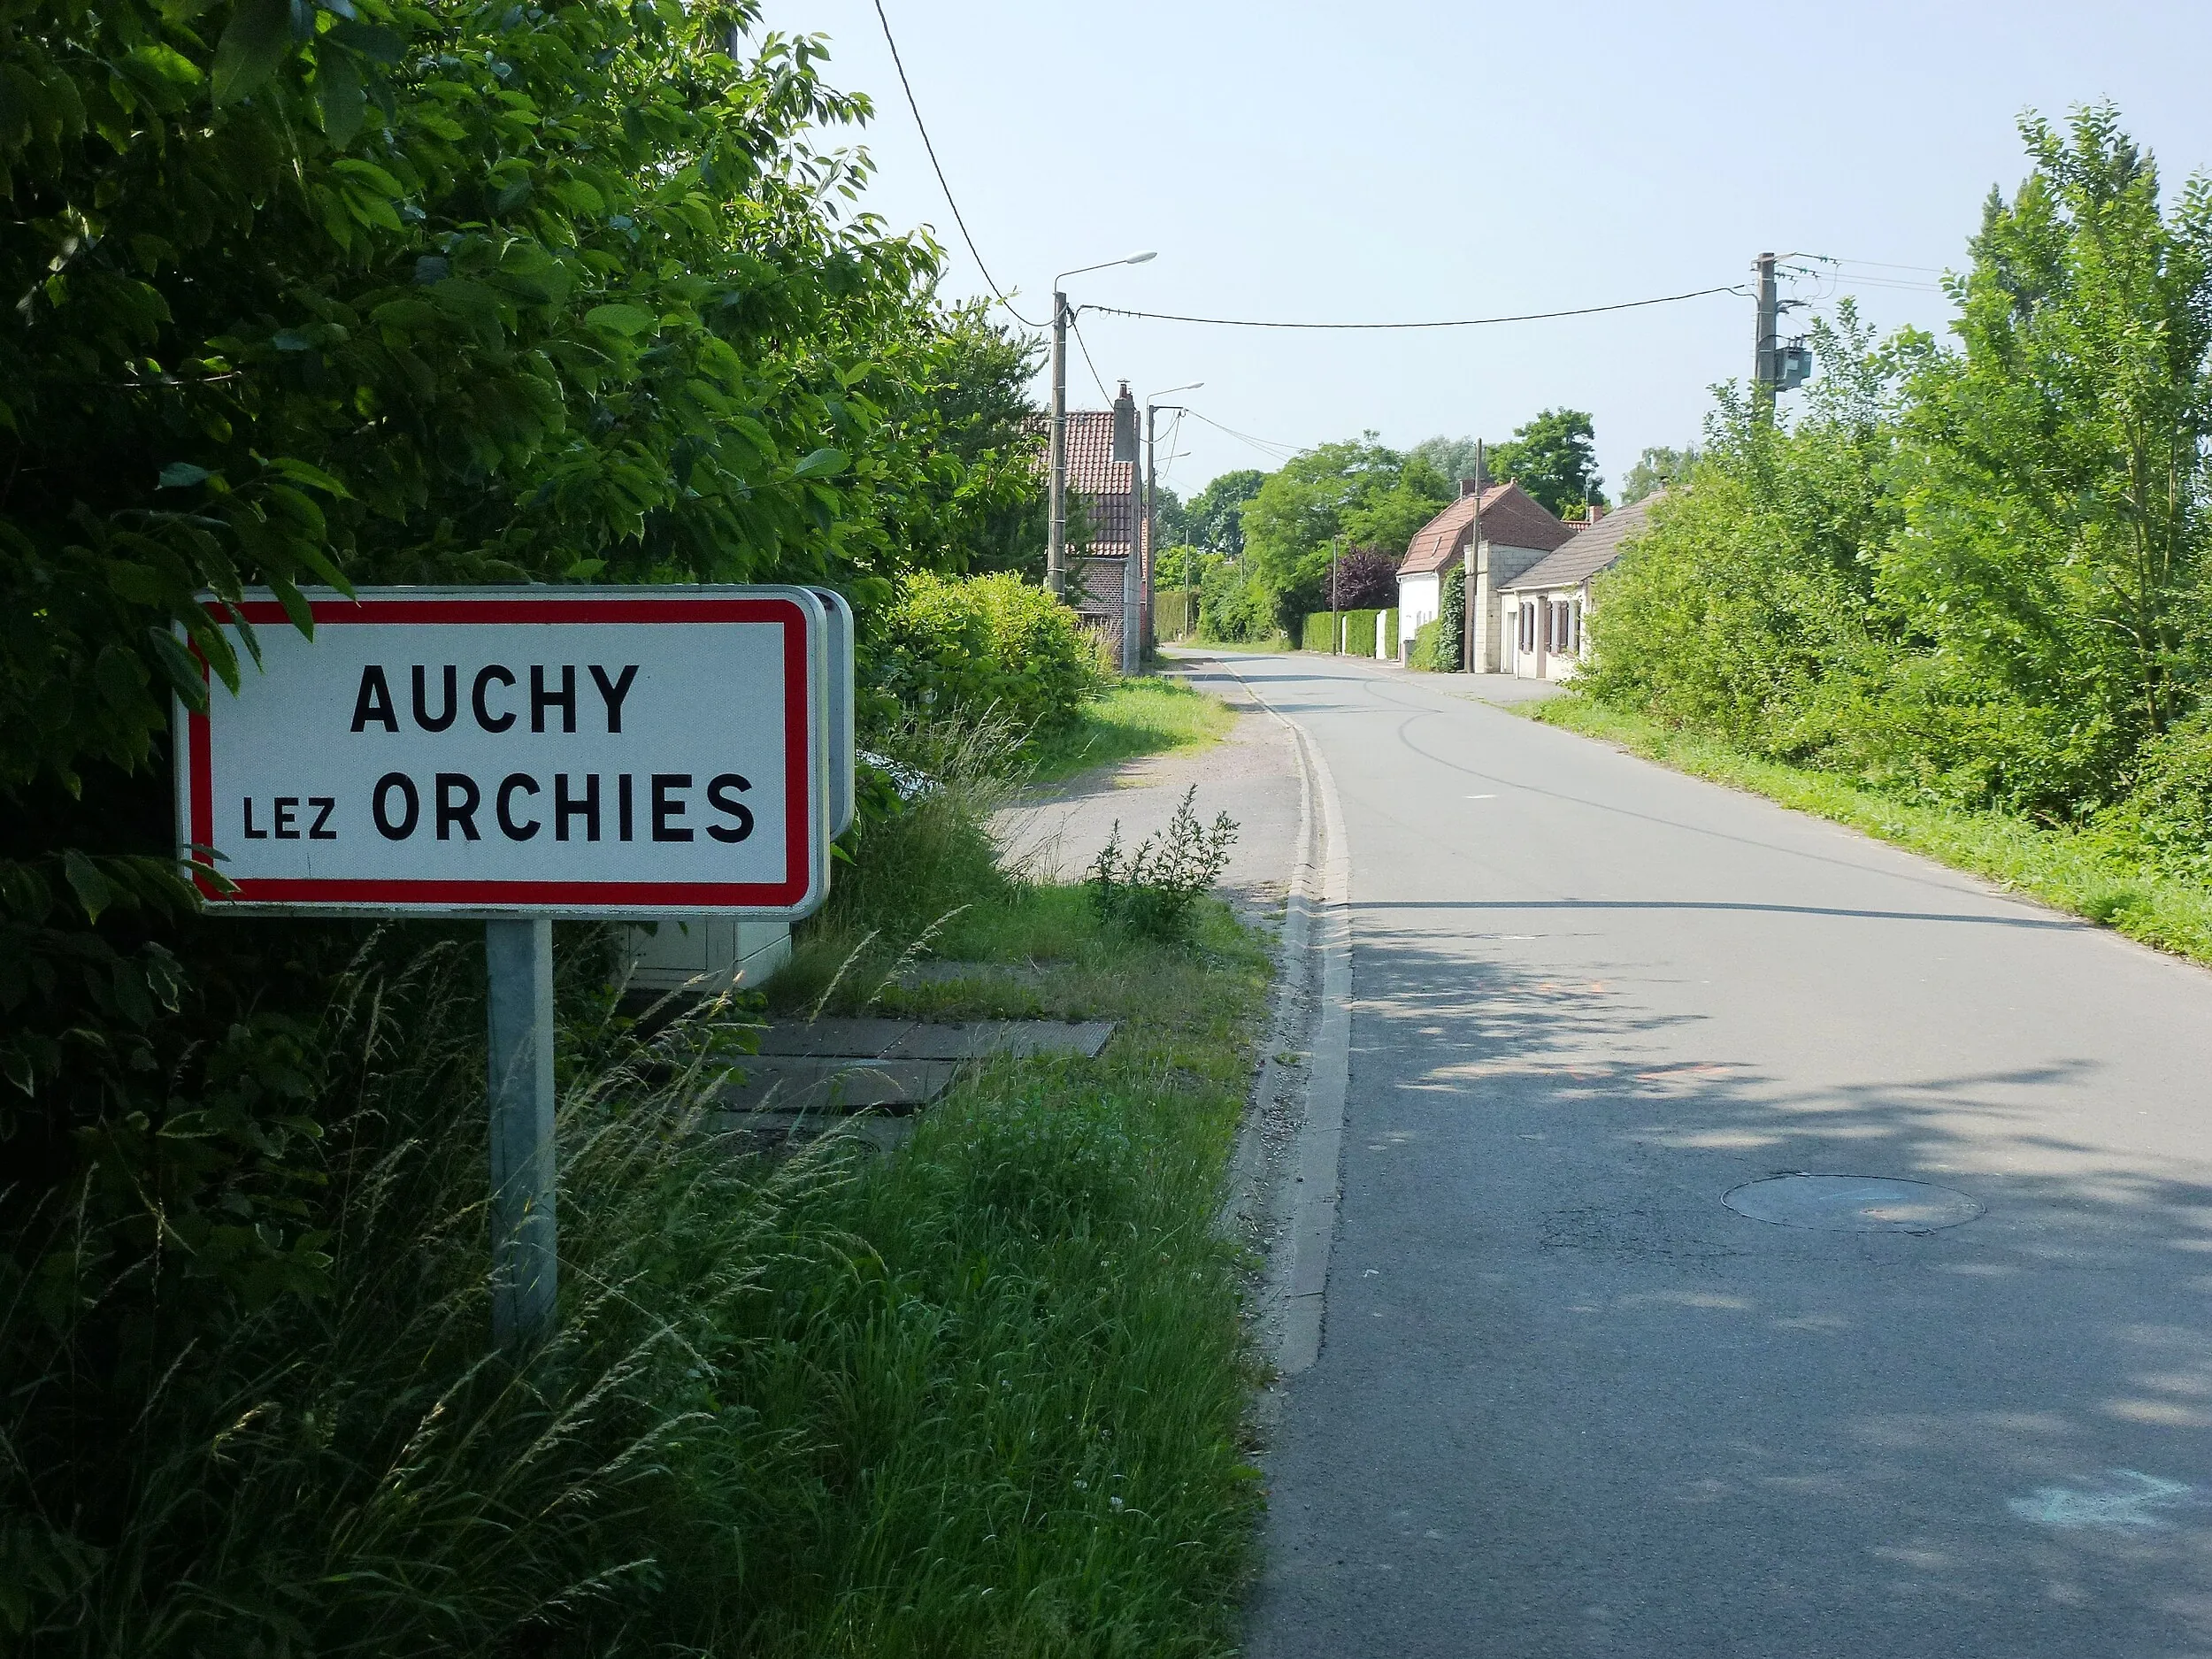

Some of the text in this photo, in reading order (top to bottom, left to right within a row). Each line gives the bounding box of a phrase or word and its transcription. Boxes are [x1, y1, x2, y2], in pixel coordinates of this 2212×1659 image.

[349, 664, 640, 734] AUCHY
[242, 772, 756, 845] LEZ ORCHIES
